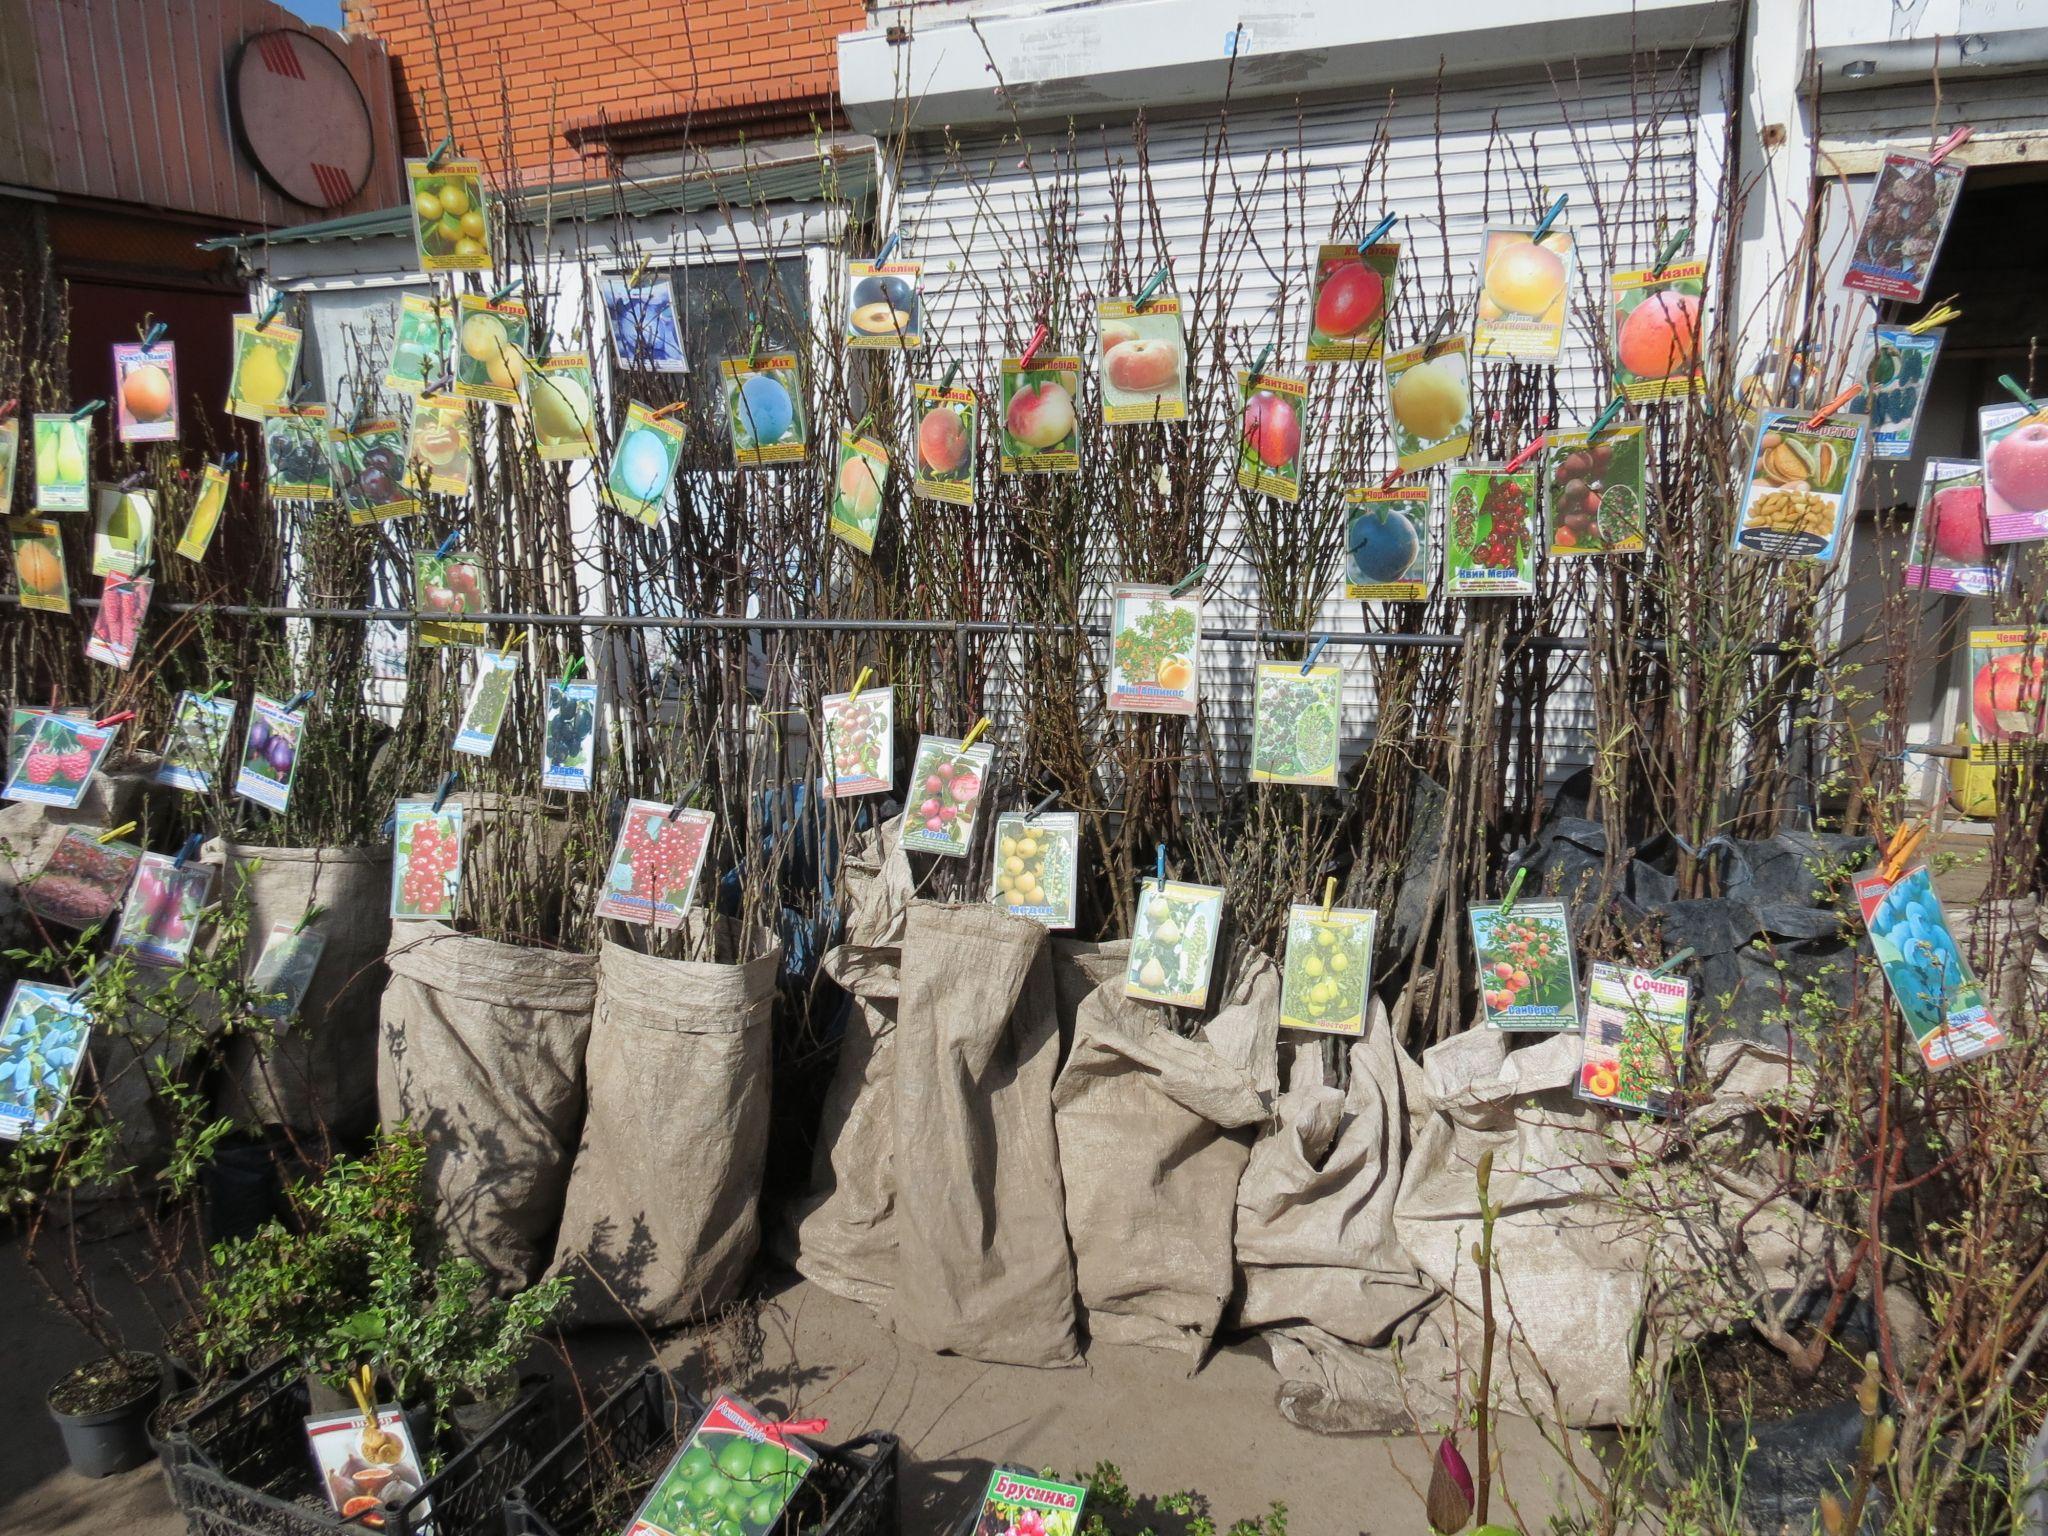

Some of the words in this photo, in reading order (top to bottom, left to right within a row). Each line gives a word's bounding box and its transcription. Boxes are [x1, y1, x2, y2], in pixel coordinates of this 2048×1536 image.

[1643, 263, 1701, 282] Цнамі
[1127, 303, 1177, 315] Стурн
[677, 815, 708, 825] орічка
[1633, 976, 1686, 999] Сочний
[994, 1474, 1077, 1509] Брусинка
